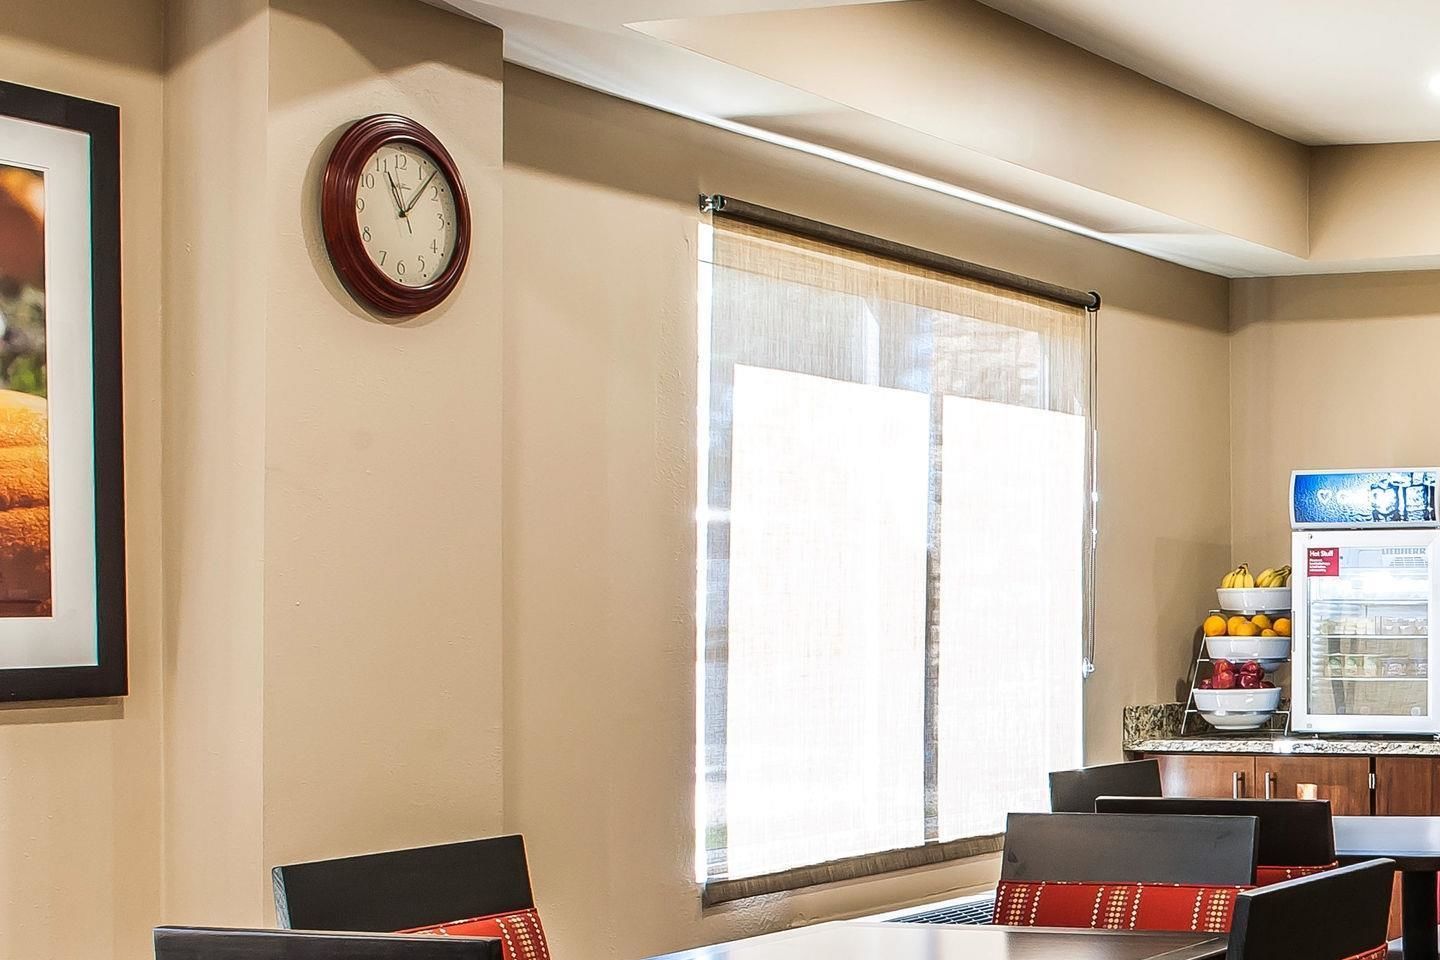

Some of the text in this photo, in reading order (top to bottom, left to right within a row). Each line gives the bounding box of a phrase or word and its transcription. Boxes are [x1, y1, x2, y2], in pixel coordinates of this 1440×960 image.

[375, 157, 388, 174] 11
[394, 154, 408, 170] 12
[361, 173, 375, 189] 10
[431, 186, 438, 202] 2
[357, 198, 365, 213] 9
[437, 213, 445, 231] 3
[362, 226, 372, 242] 8
[430, 239, 438, 254] 4
[379, 250, 387, 266] 7
[417, 255, 426, 273] 5
[397, 260, 406, 276] 6
